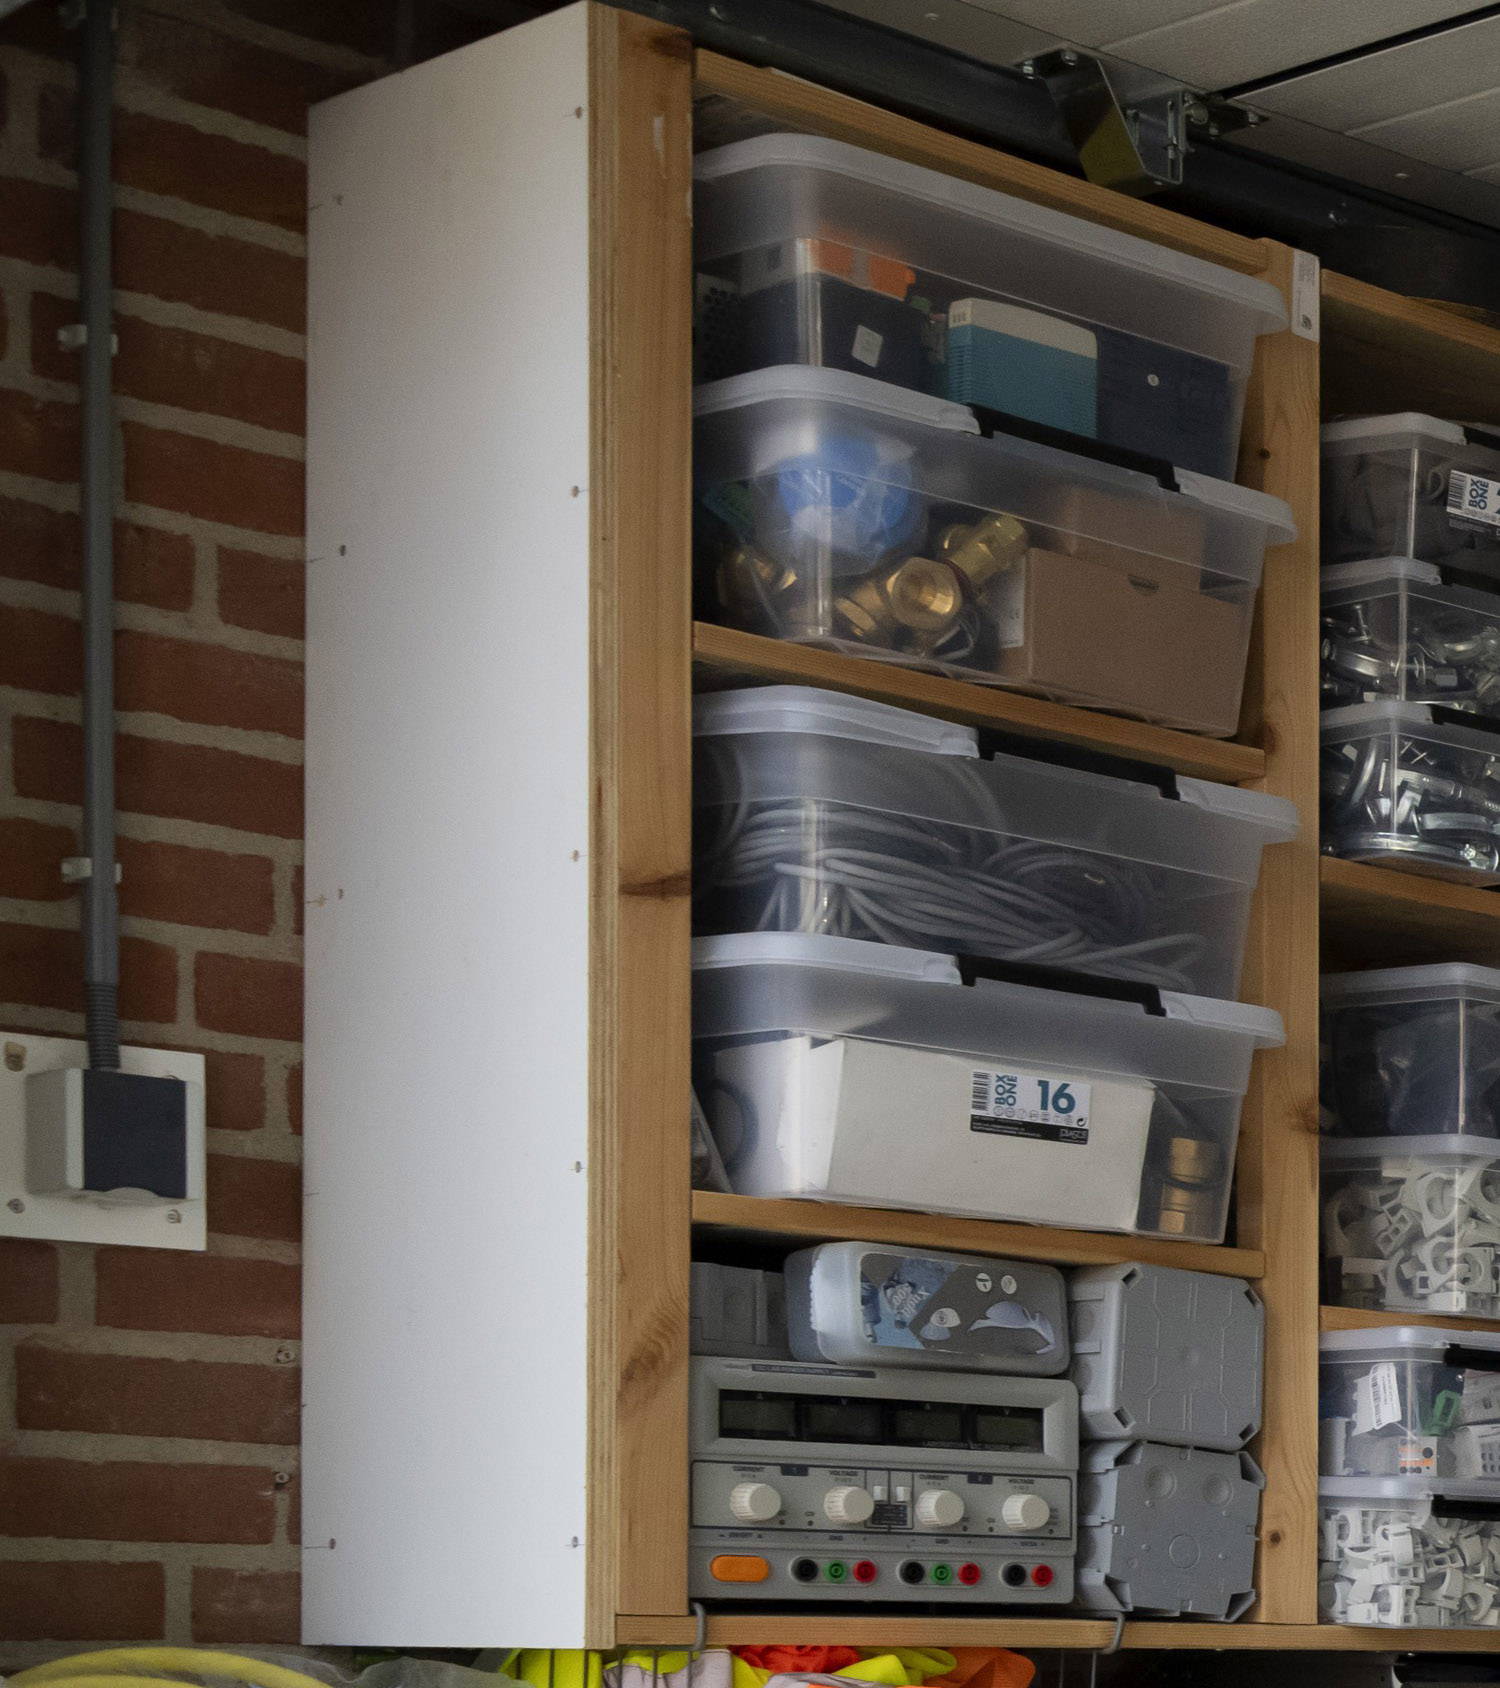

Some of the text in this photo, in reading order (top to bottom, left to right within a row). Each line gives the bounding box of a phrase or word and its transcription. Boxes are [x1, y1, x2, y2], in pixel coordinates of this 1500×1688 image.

[1468, 478, 1480, 508] BOX
[1478, 480, 1489, 510] ONE
[994, 1074, 1007, 1105] BOX
[1005, 1075, 1018, 1106] ONE
[1037, 1079, 1076, 1114] 16
